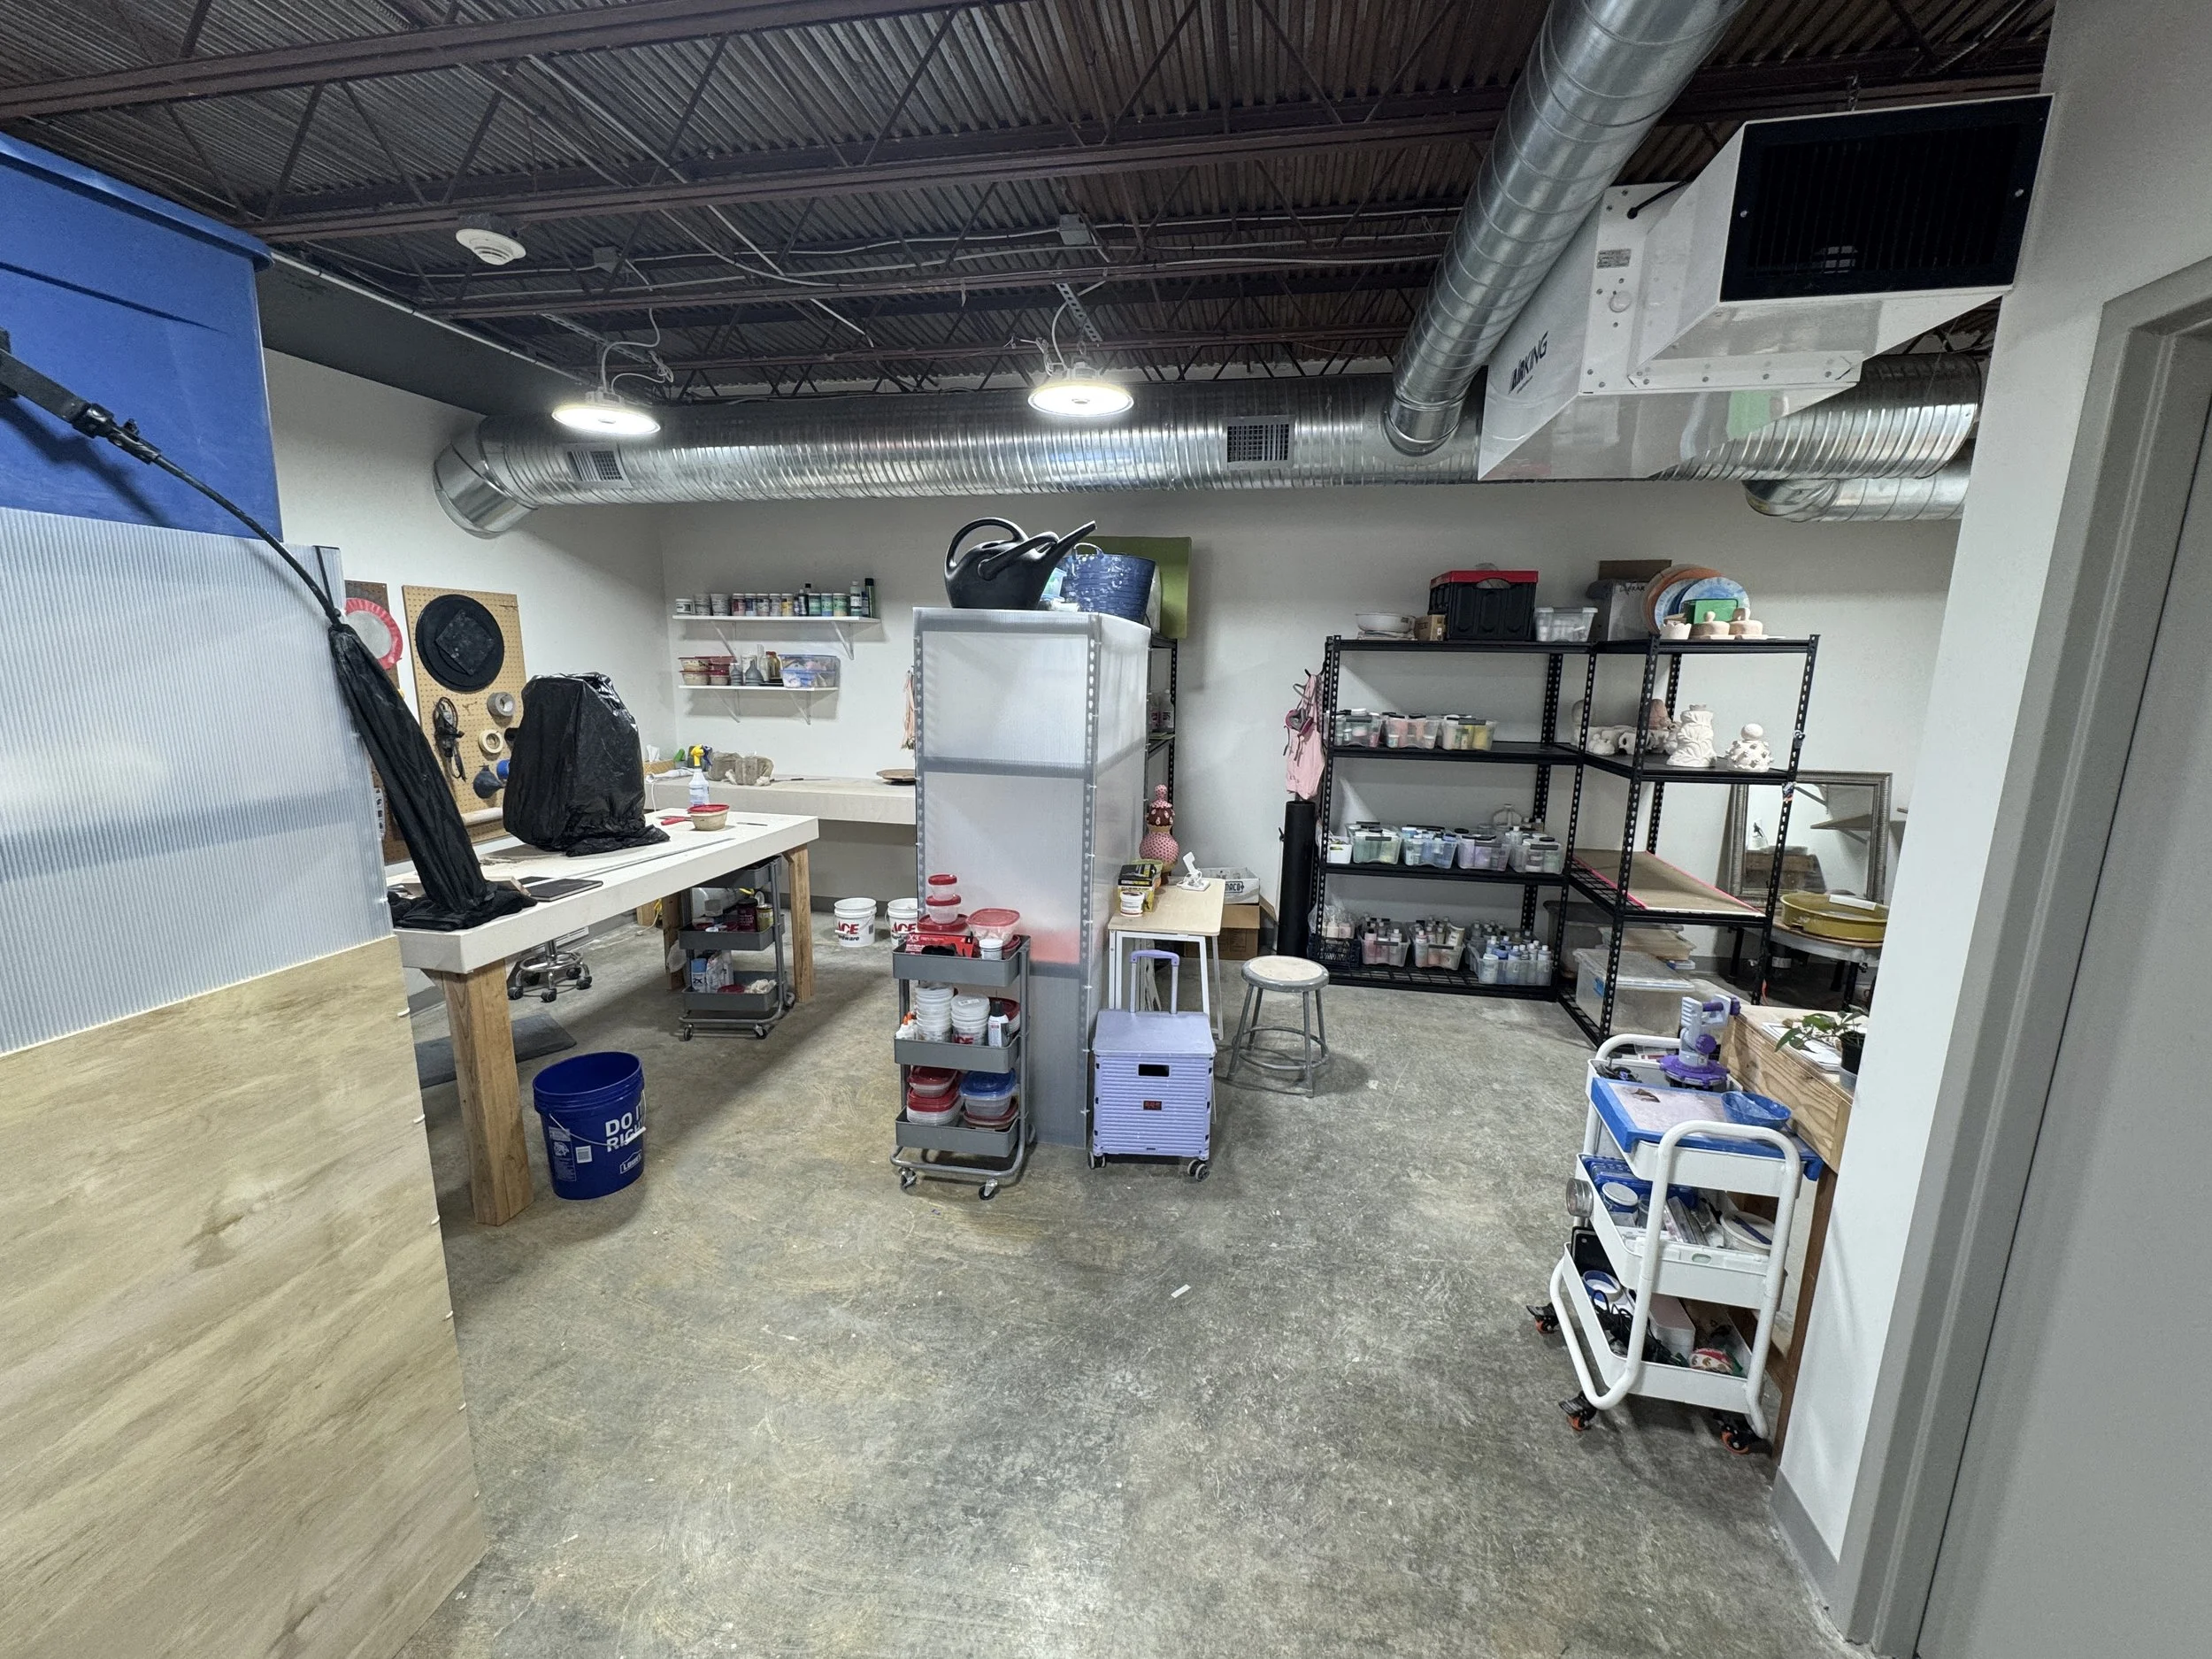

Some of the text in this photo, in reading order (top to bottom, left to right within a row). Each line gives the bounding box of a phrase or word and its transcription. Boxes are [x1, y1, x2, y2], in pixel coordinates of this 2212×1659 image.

[1508, 331, 1548, 395] AIRKING
[838, 921, 859, 934] ACE
[605, 1112, 633, 1138] DO
[607, 1124, 642, 1152] RIGH
